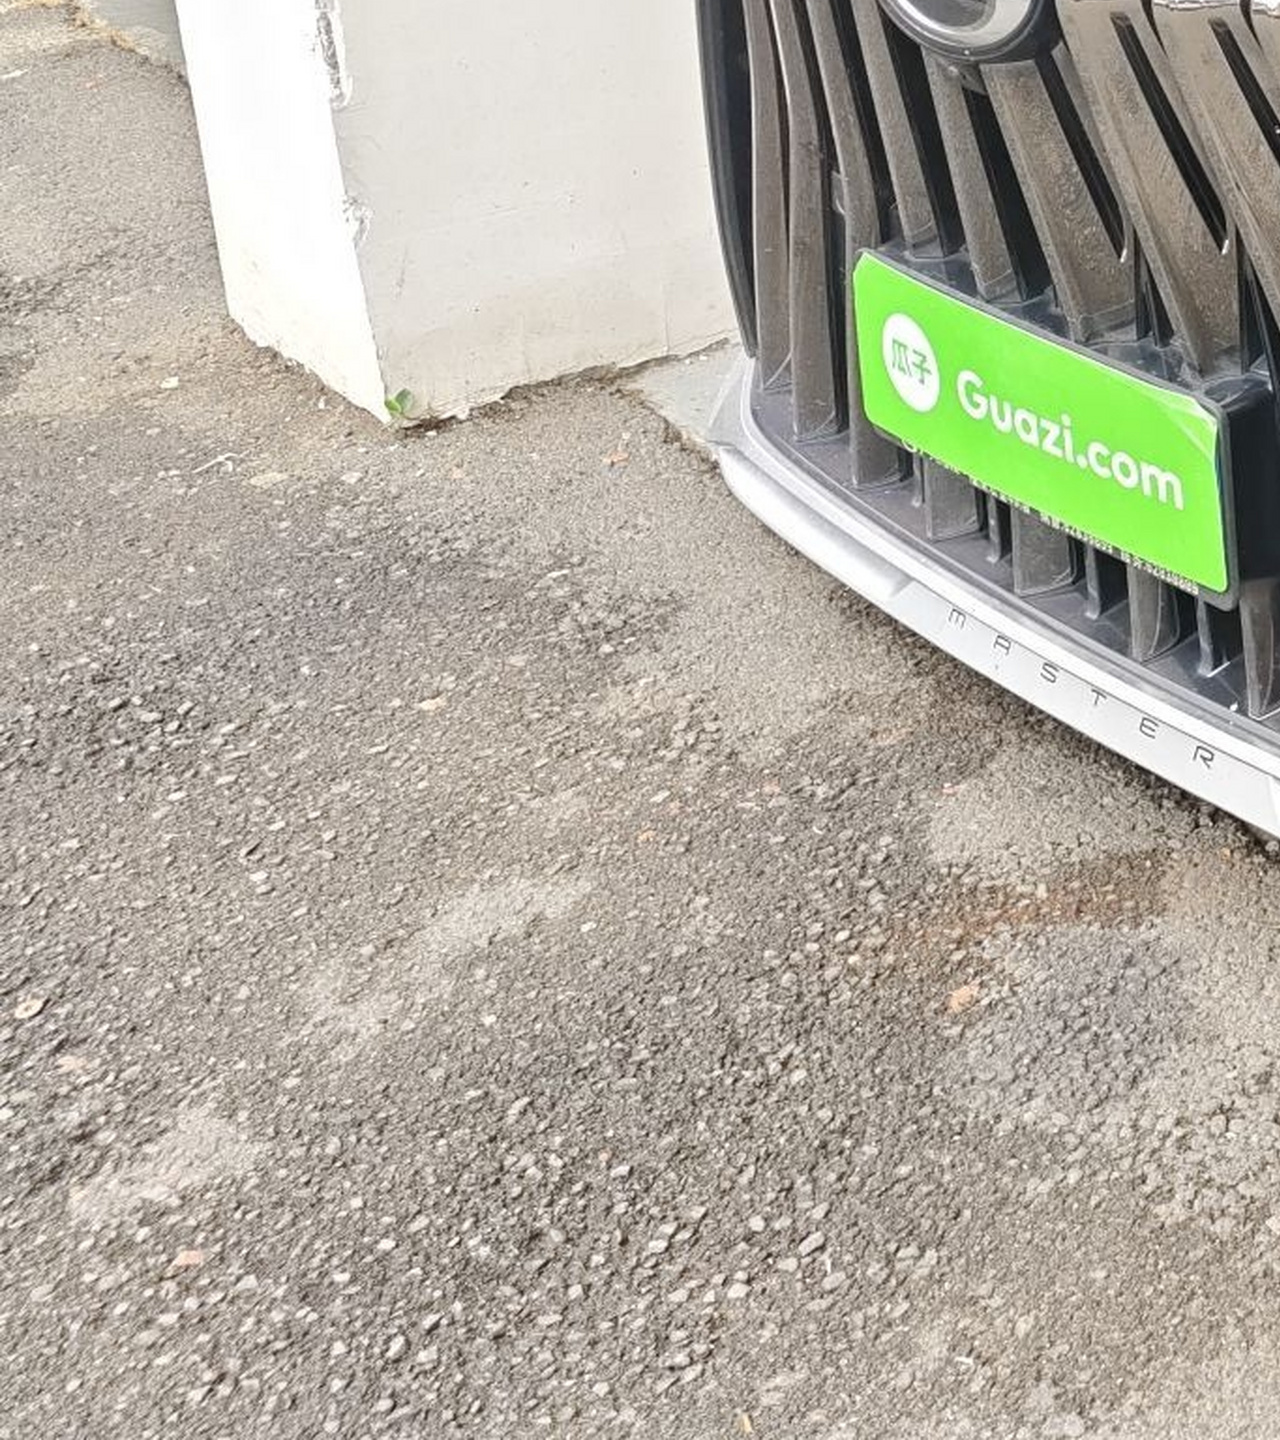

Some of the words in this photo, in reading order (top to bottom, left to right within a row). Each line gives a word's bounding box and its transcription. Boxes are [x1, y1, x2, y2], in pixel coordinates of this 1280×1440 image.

[891, 338, 933, 386] 瓜子
[957, 370, 1185, 511] Guazi.com
[948, 608, 1215, 769] MASTER
